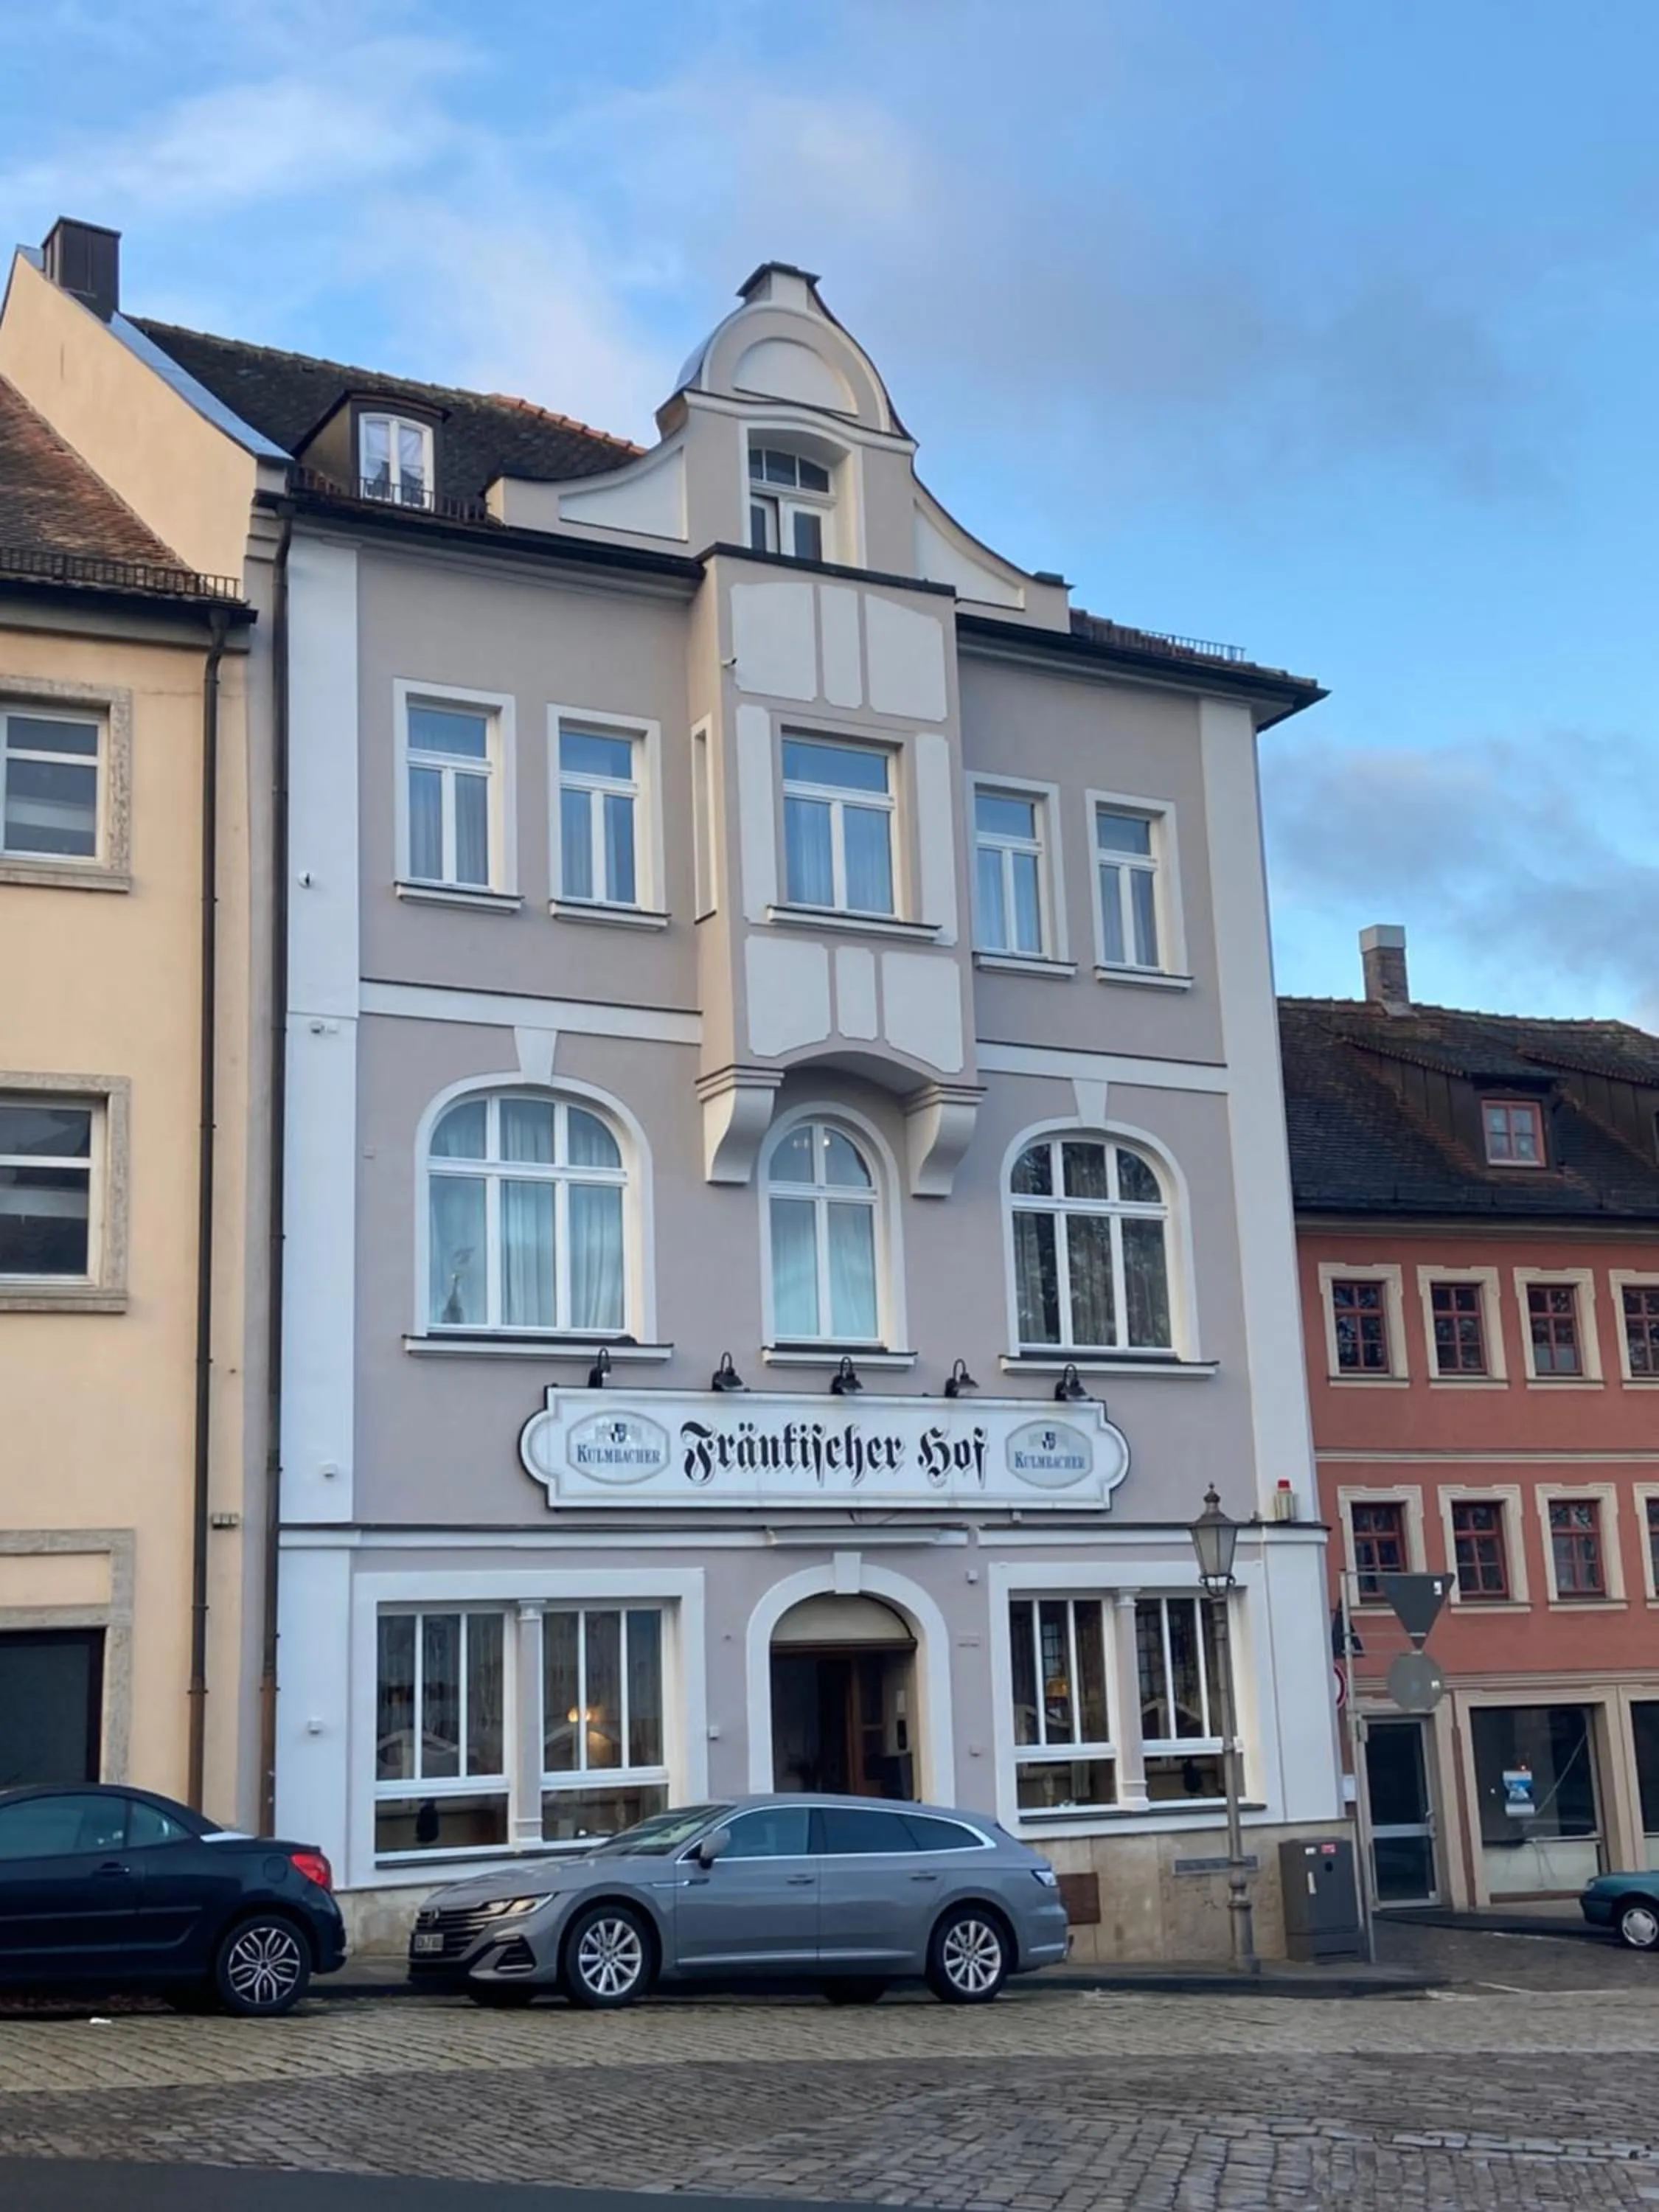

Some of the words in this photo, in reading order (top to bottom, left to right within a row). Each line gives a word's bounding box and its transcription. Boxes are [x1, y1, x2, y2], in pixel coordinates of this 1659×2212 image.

[577, 1443, 661, 1464] KULMBACHER
[917, 1426, 987, 1486] Hof
[1014, 1450, 1086, 1470] KULMBACHER
